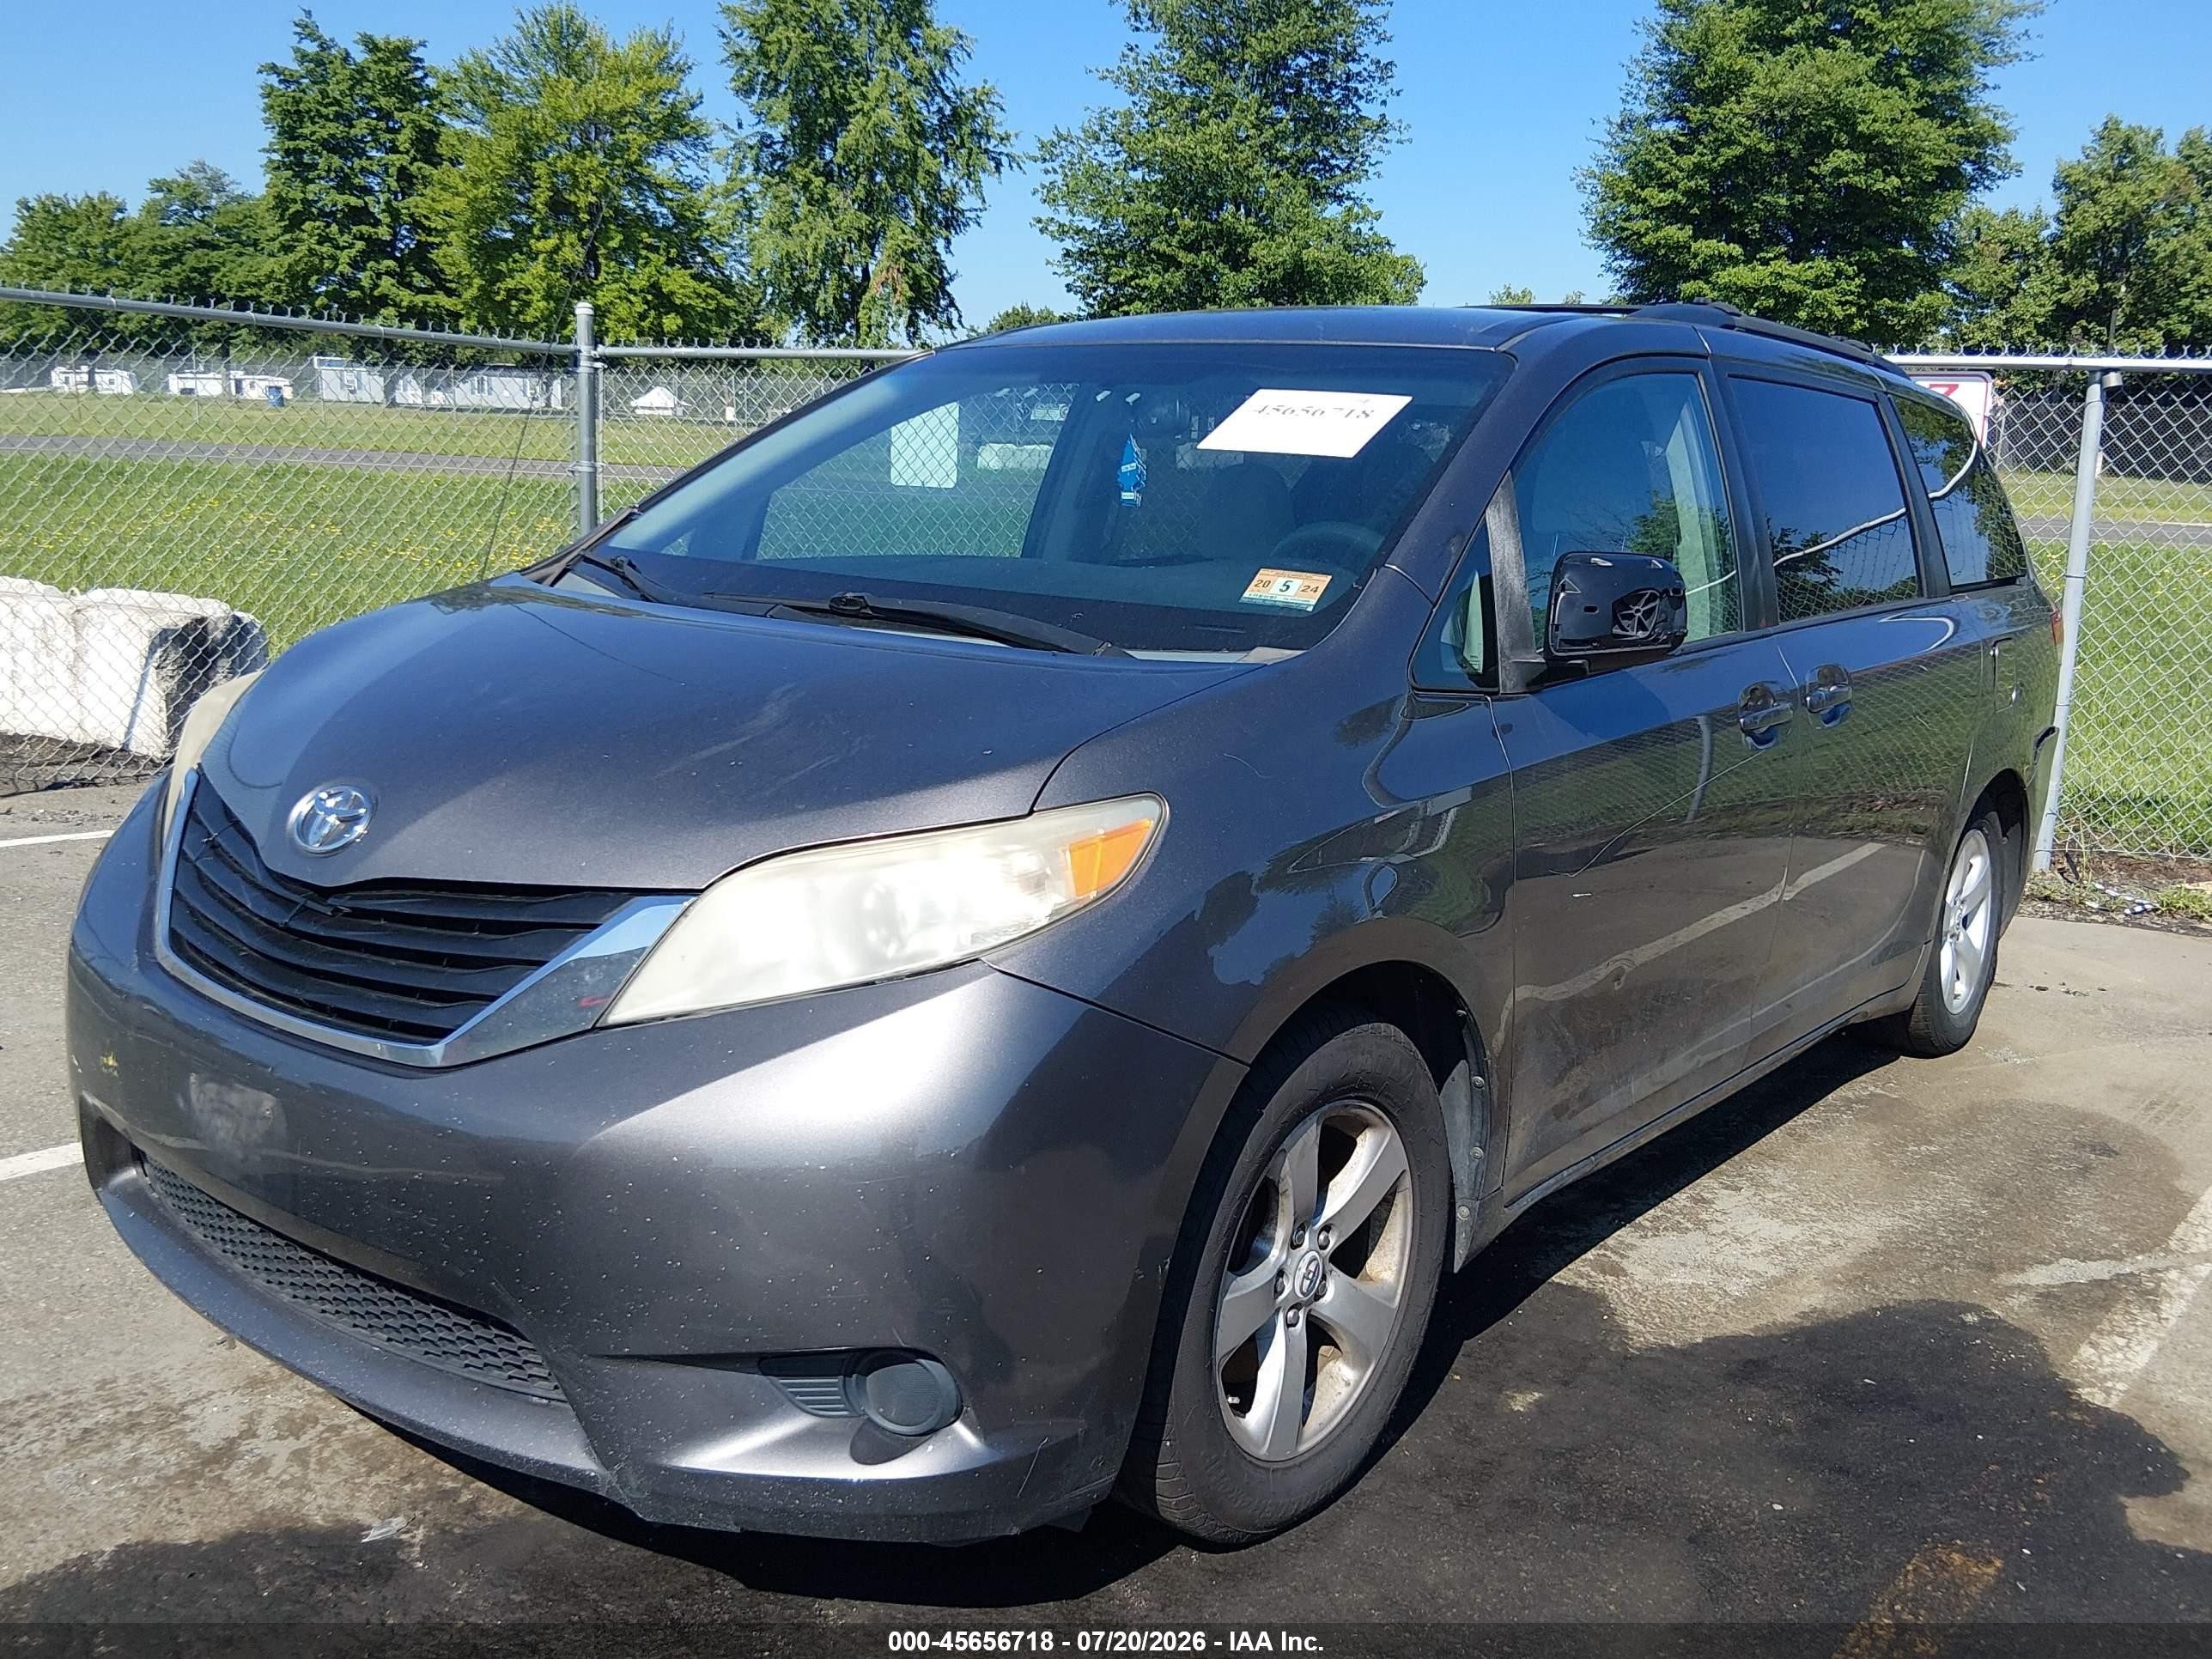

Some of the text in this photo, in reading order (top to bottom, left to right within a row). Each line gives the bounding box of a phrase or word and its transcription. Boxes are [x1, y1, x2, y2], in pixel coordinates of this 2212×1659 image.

[1254, 579, 1320, 594] 20 5 24
